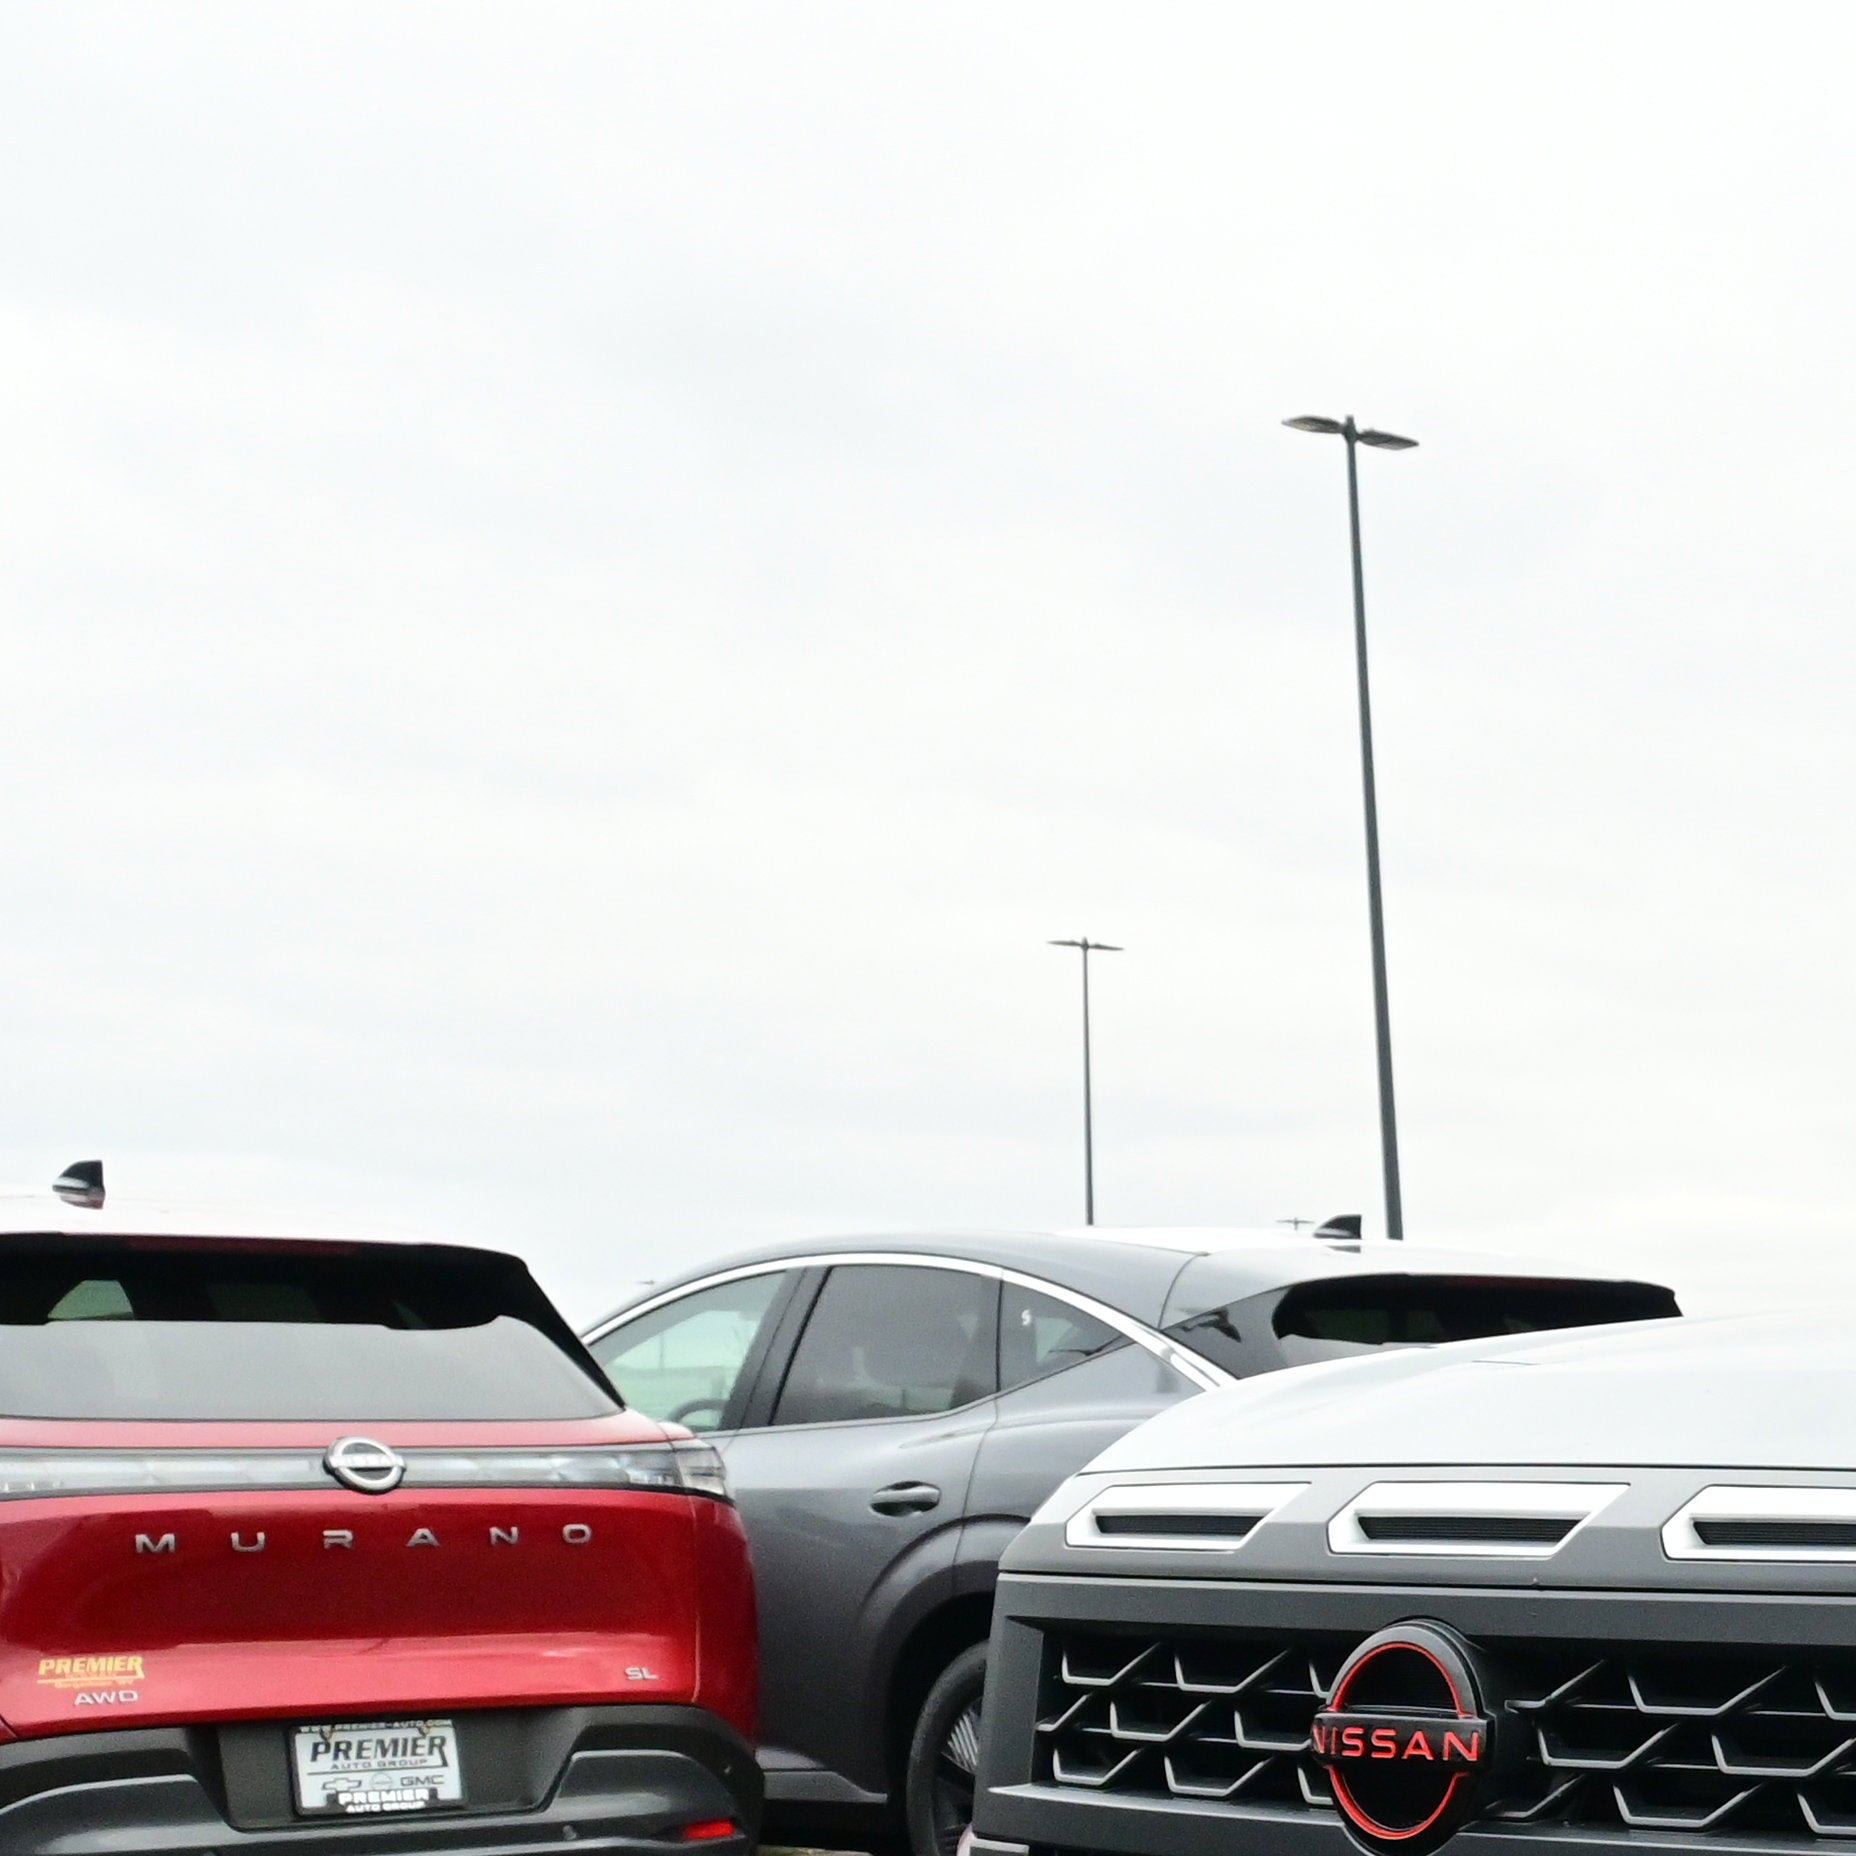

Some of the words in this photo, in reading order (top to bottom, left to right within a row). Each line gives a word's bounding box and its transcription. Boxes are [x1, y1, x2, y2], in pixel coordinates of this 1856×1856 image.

[134, 1522, 593, 1555] MURANO
[38, 1655, 146, 1680] PREMIER
[624, 1666, 659, 1681] SL
[74, 1689, 139, 1706] AWD
[1312, 1723, 1480, 1762] NISSAN
[310, 1735, 449, 1768] PREMIER
[330, 1761, 372, 1771] AUTO
[377, 1758, 429, 1768] GROUP
[400, 1774, 445, 1788] GMC
[338, 1788, 430, 1806] PREMIER
[345, 1801, 381, 1814] AUTO
[382, 1800, 427, 1812] GROUP
